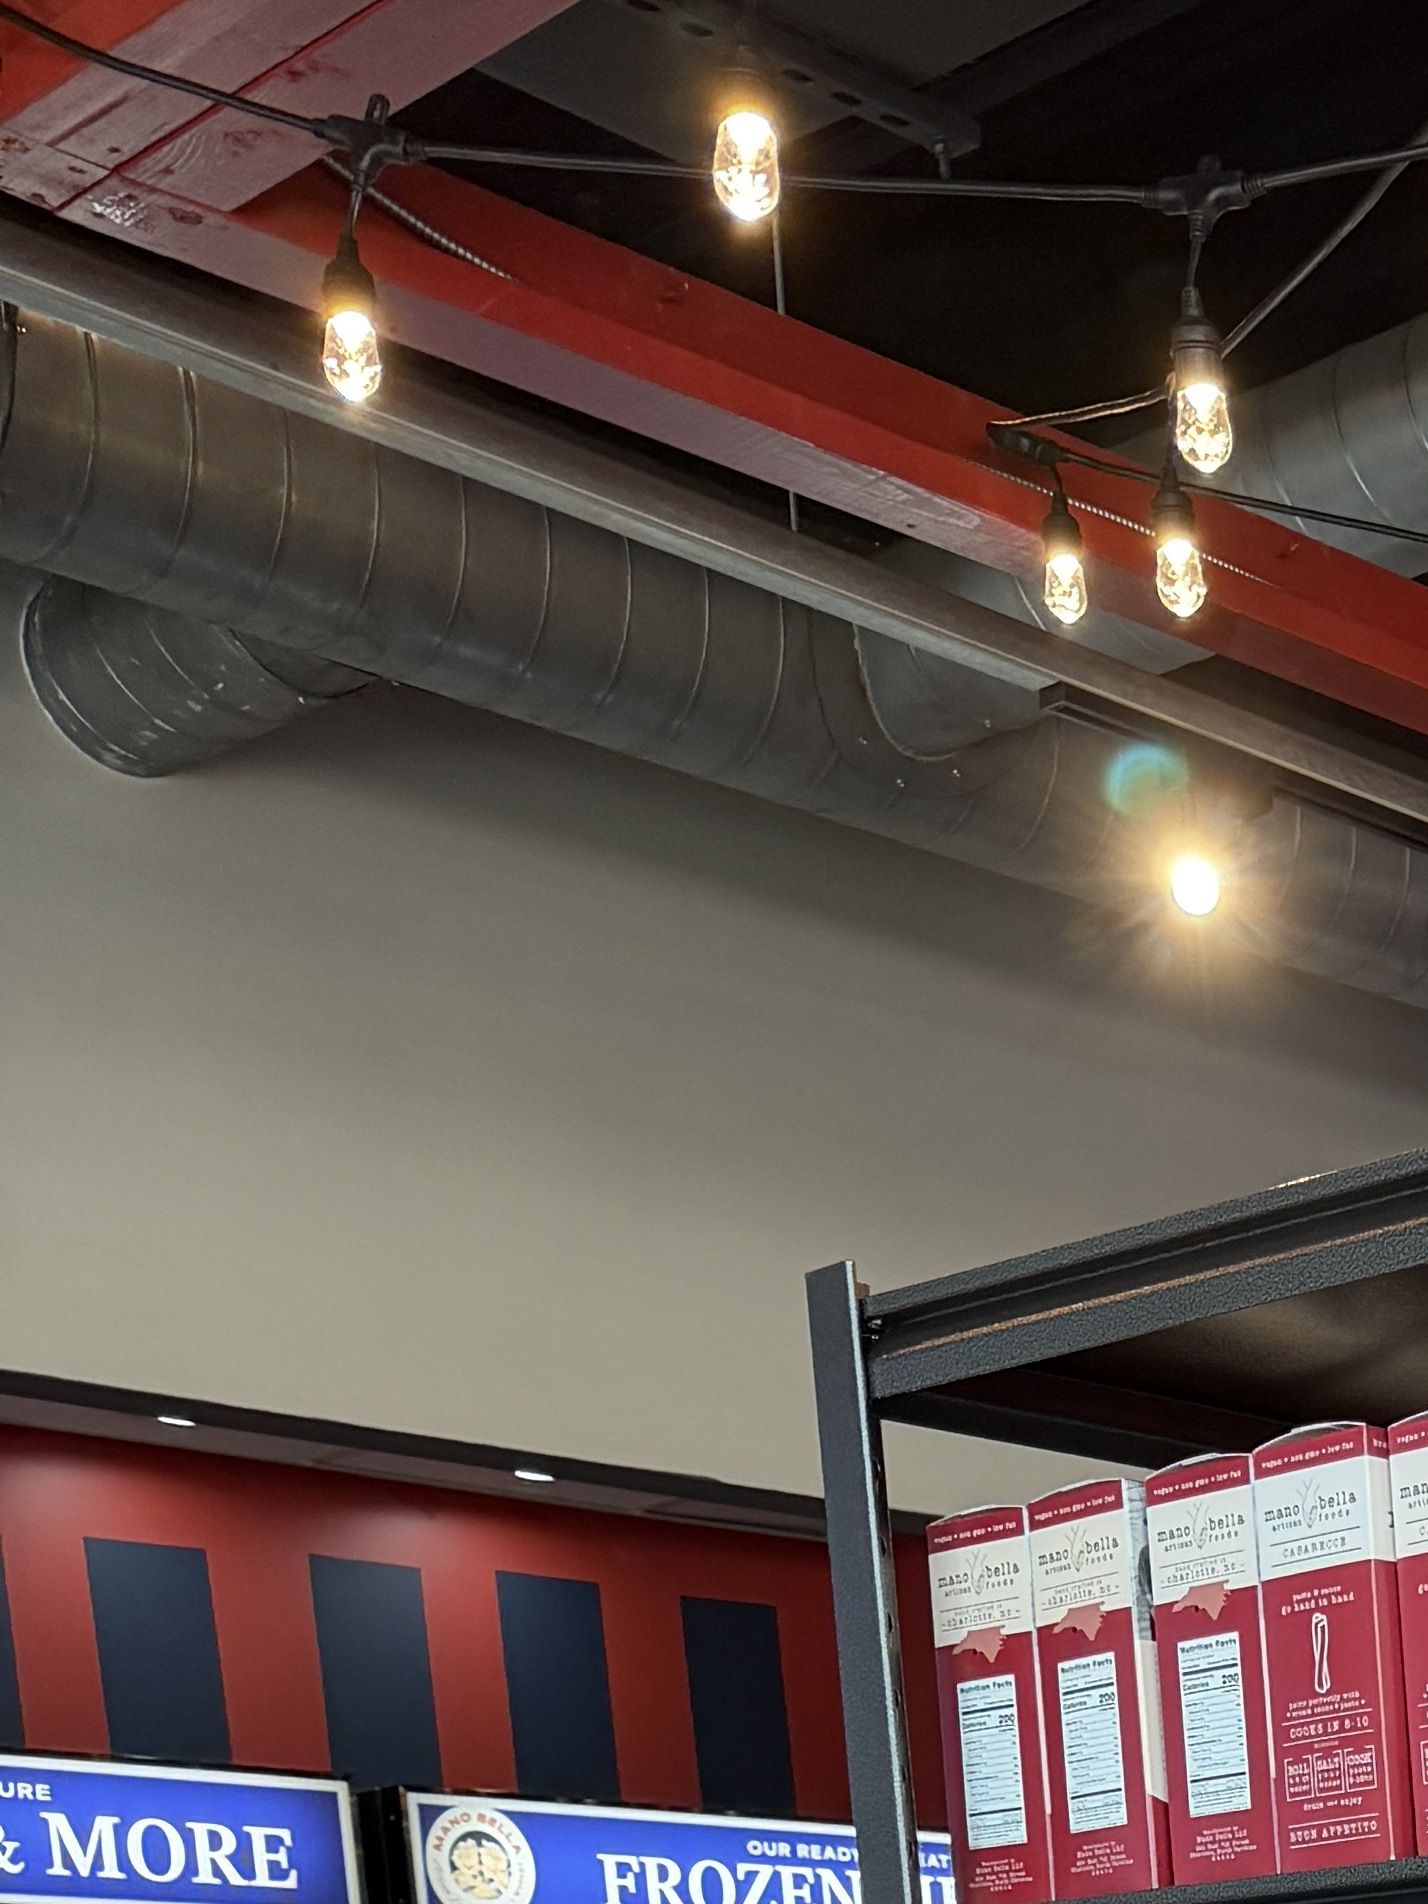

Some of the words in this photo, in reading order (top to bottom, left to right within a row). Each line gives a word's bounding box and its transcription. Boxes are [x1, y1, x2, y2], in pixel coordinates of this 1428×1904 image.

[39, 1812, 298, 1888] MORE
[433, 1812, 471, 1852] MANO
[477, 1812, 522, 1854] BELLA
[746, 1840, 791, 1858] OUR
